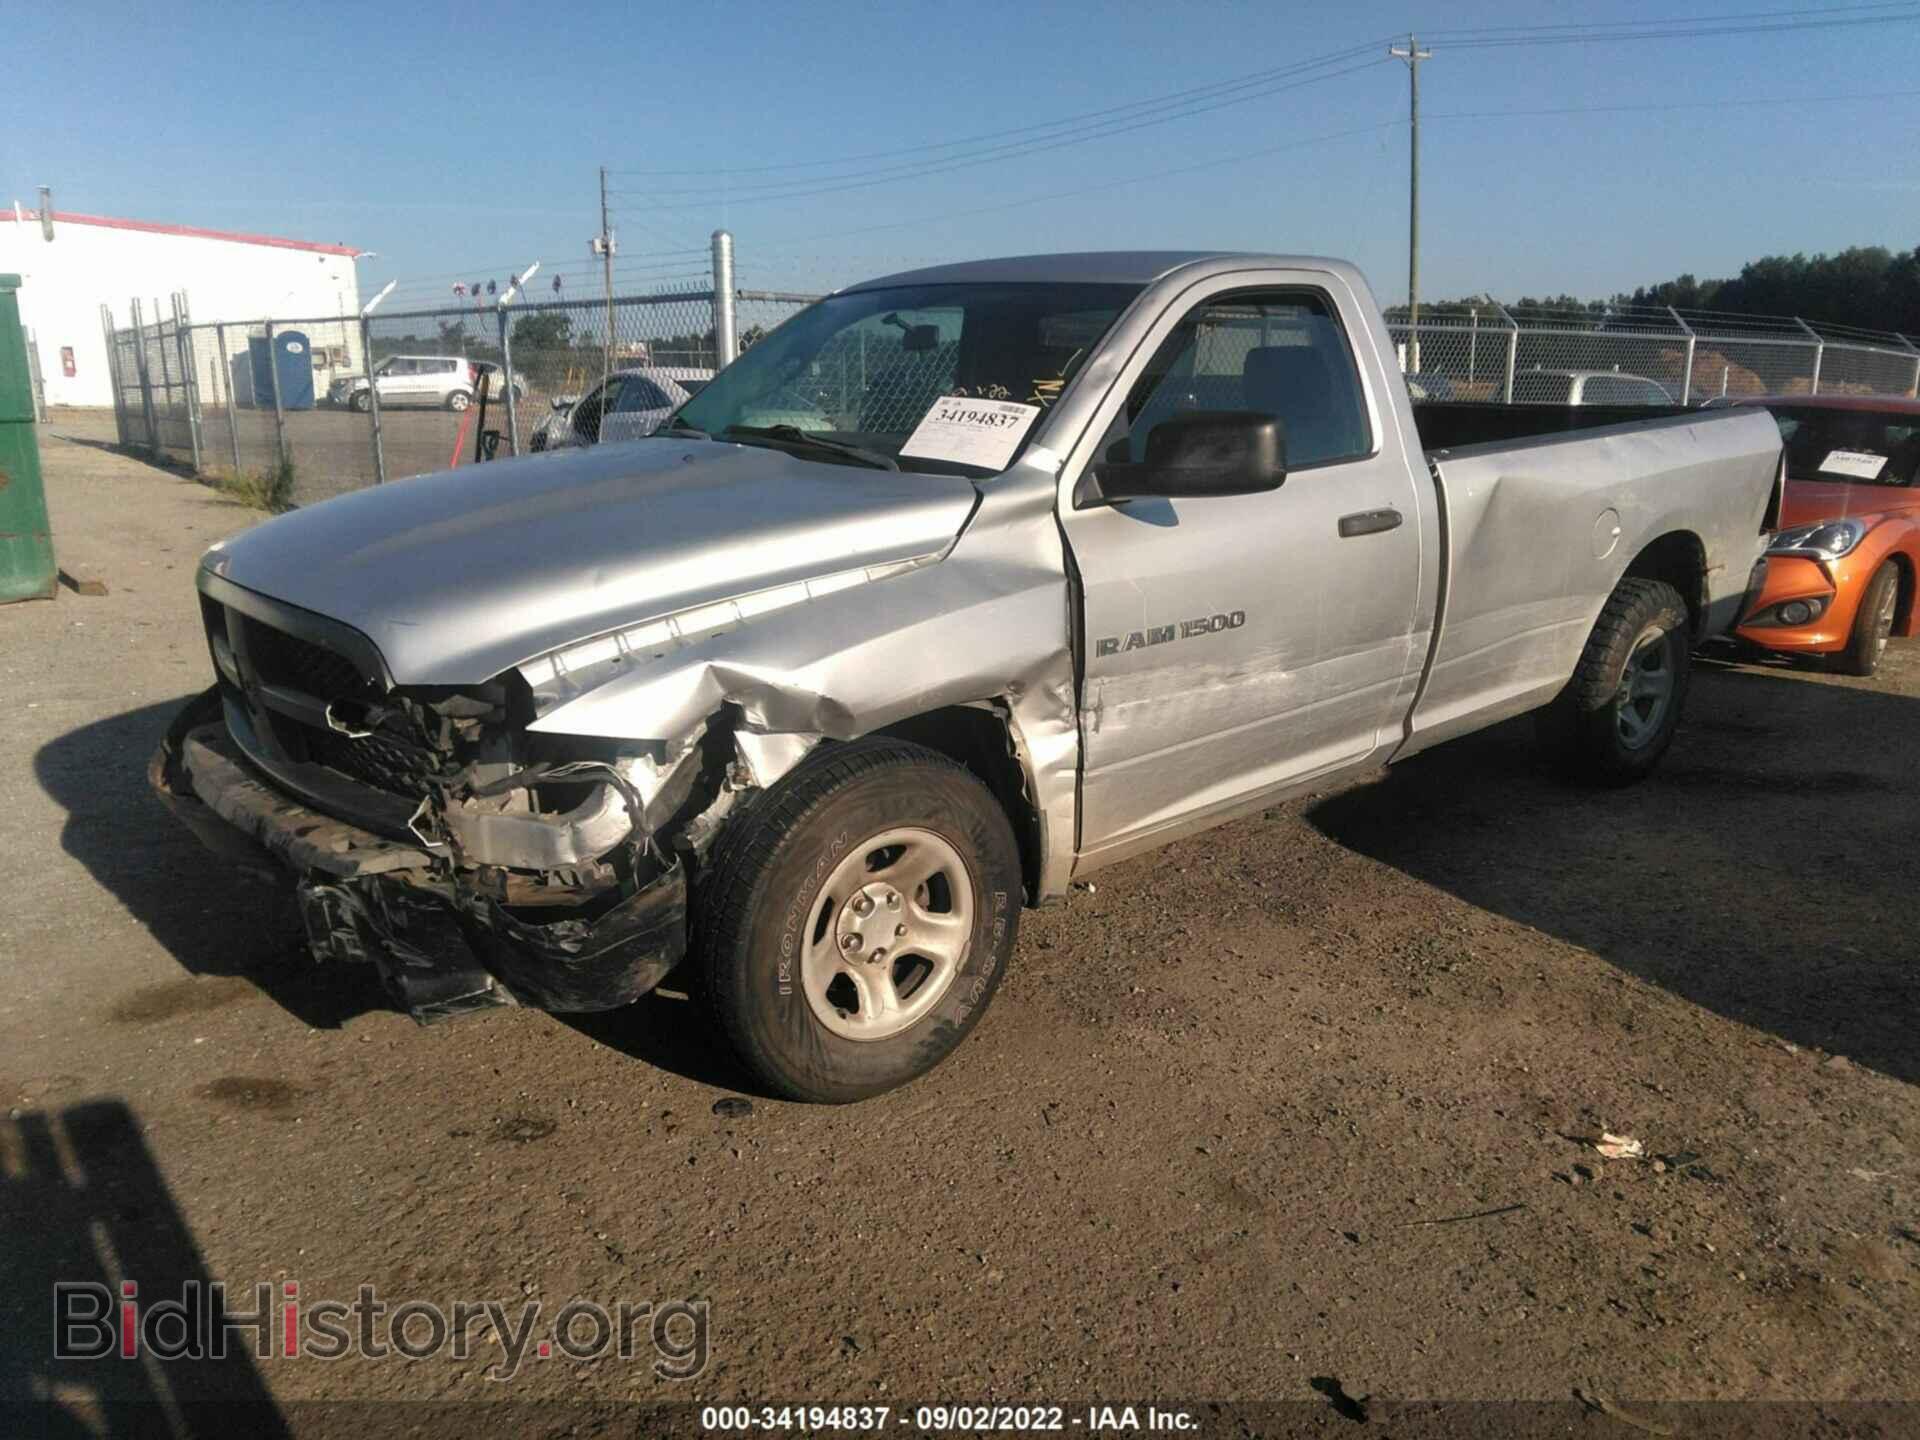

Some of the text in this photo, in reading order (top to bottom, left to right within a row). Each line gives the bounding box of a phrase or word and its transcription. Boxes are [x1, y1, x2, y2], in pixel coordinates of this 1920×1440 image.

[936, 408, 1019, 429] 34194837
[1096, 610, 1246, 658] RAM 1500
[779, 832, 848, 996] IRONMAN
